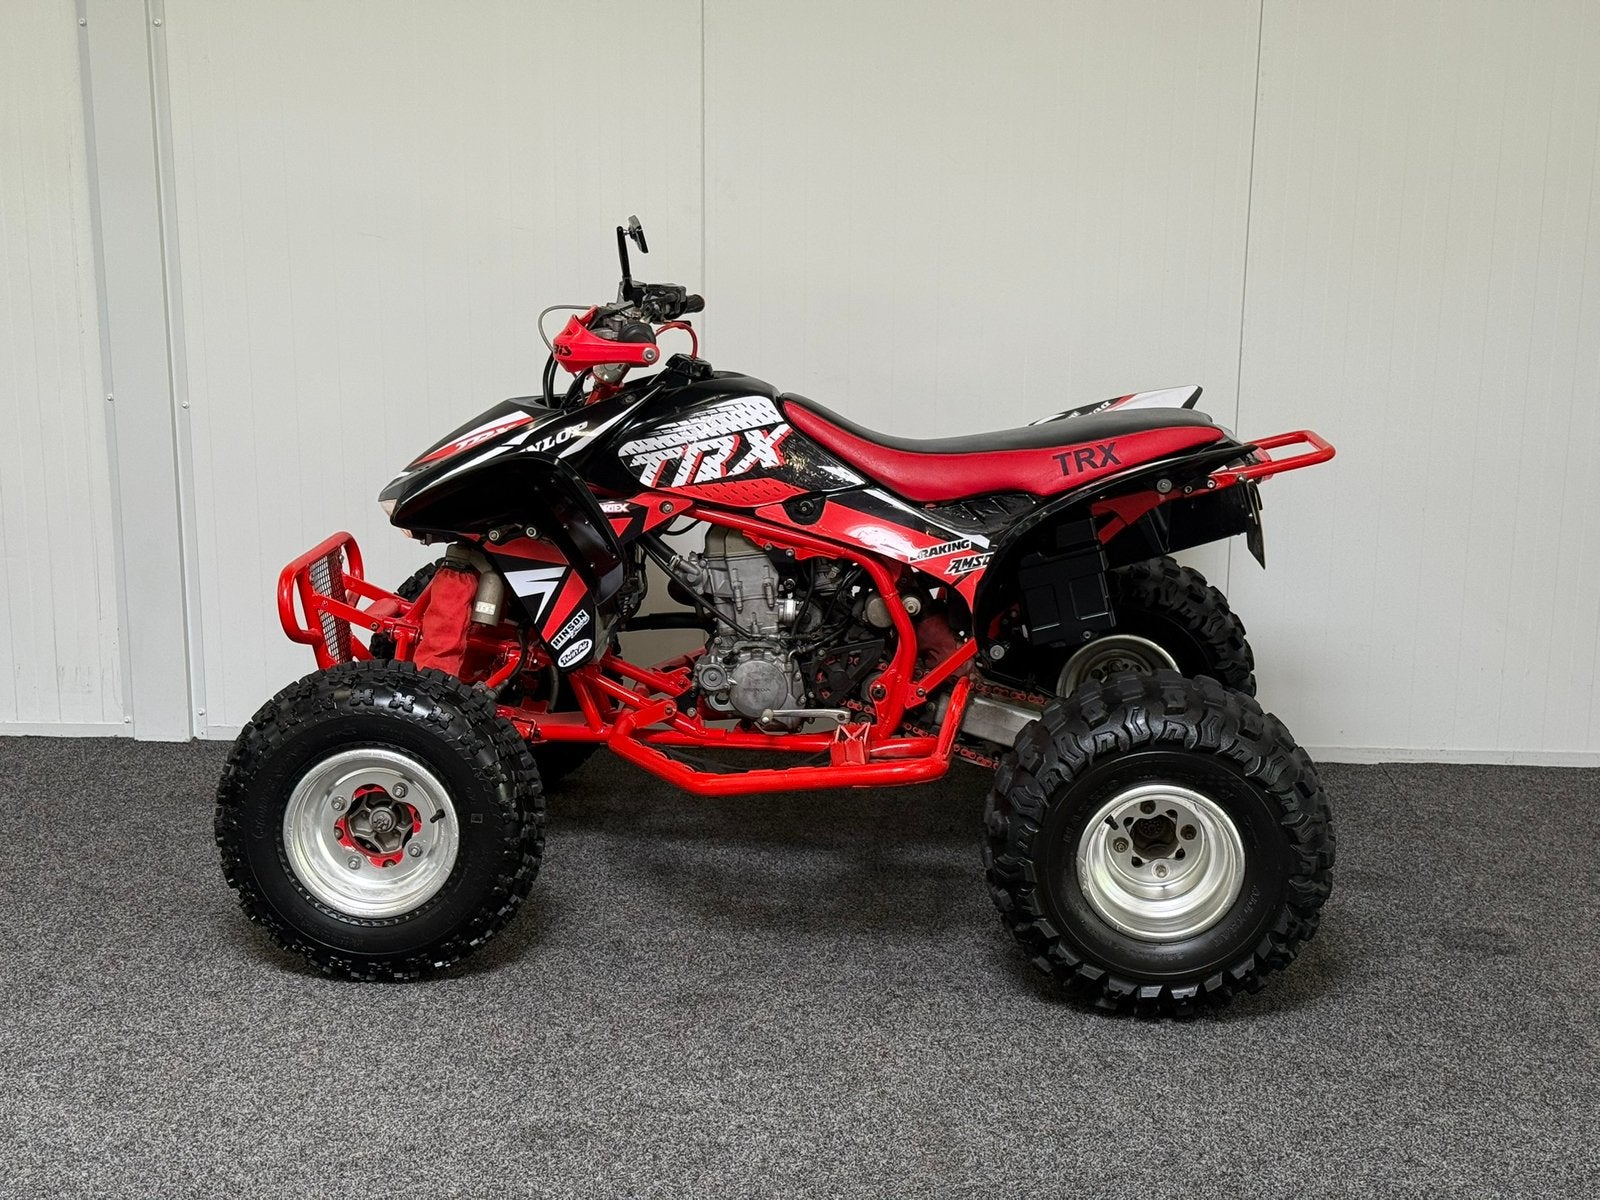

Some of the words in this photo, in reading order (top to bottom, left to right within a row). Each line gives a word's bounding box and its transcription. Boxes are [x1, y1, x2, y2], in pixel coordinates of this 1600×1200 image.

[520, 421, 589, 453] NLOP
[630, 423, 790, 488] TRX
[1053, 442, 1121, 477] TRX
[910, 540, 970, 561] RAKING
[552, 611, 586, 647] HINSON
